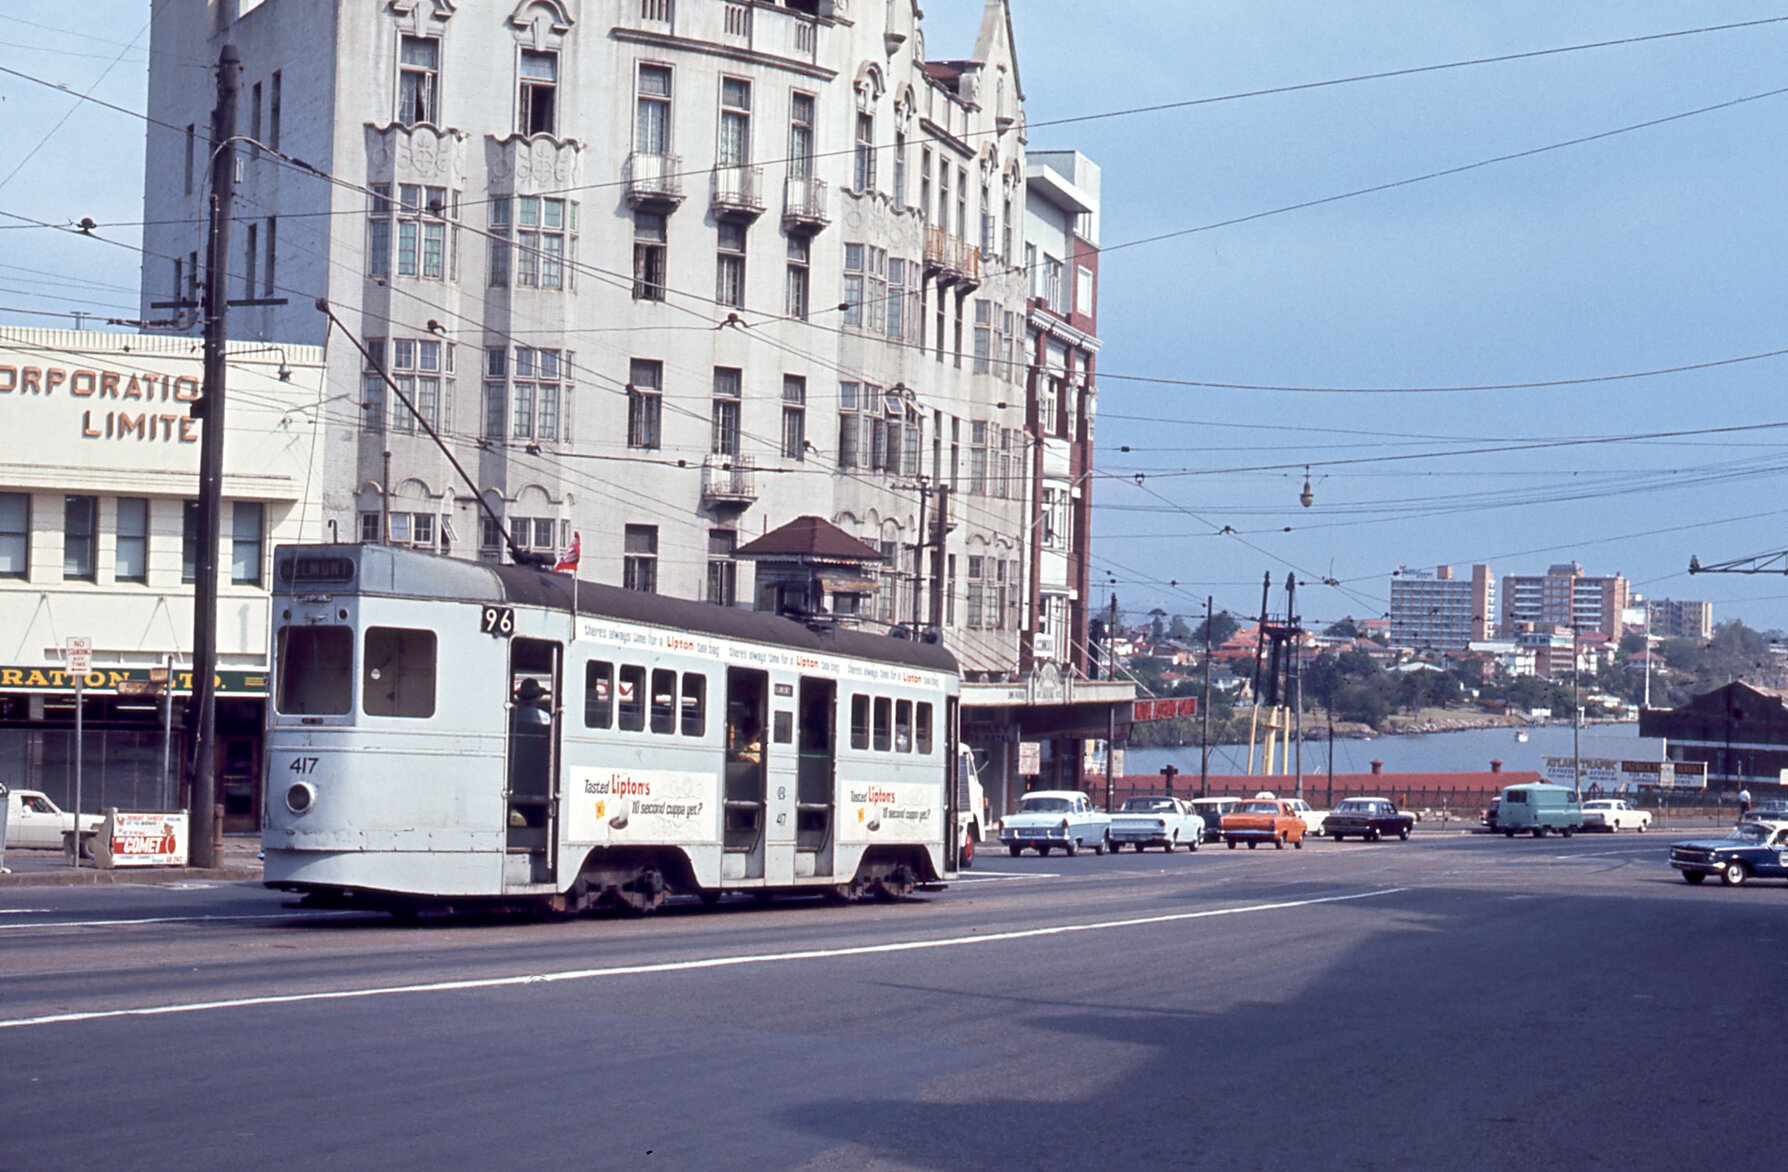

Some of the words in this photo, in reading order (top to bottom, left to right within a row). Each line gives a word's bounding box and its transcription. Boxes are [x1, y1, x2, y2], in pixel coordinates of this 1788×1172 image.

[486, 608, 511, 632] 96
[73, 640, 85, 648] NO
[667, 635, 694, 651] Lipton
[796, 655, 818, 668] Lipton
[903, 671, 922, 684] Lipton
[289, 756, 320, 775] 417
[584, 779, 610, 794] Tasted
[612, 773, 651, 799] Lipton's
[632, 800, 640, 814] 10
[640, 801, 666, 815] second
[666, 804, 686, 819] cuppa
[686, 802, 703, 819] yet?
[123, 837, 163, 854] COMET
